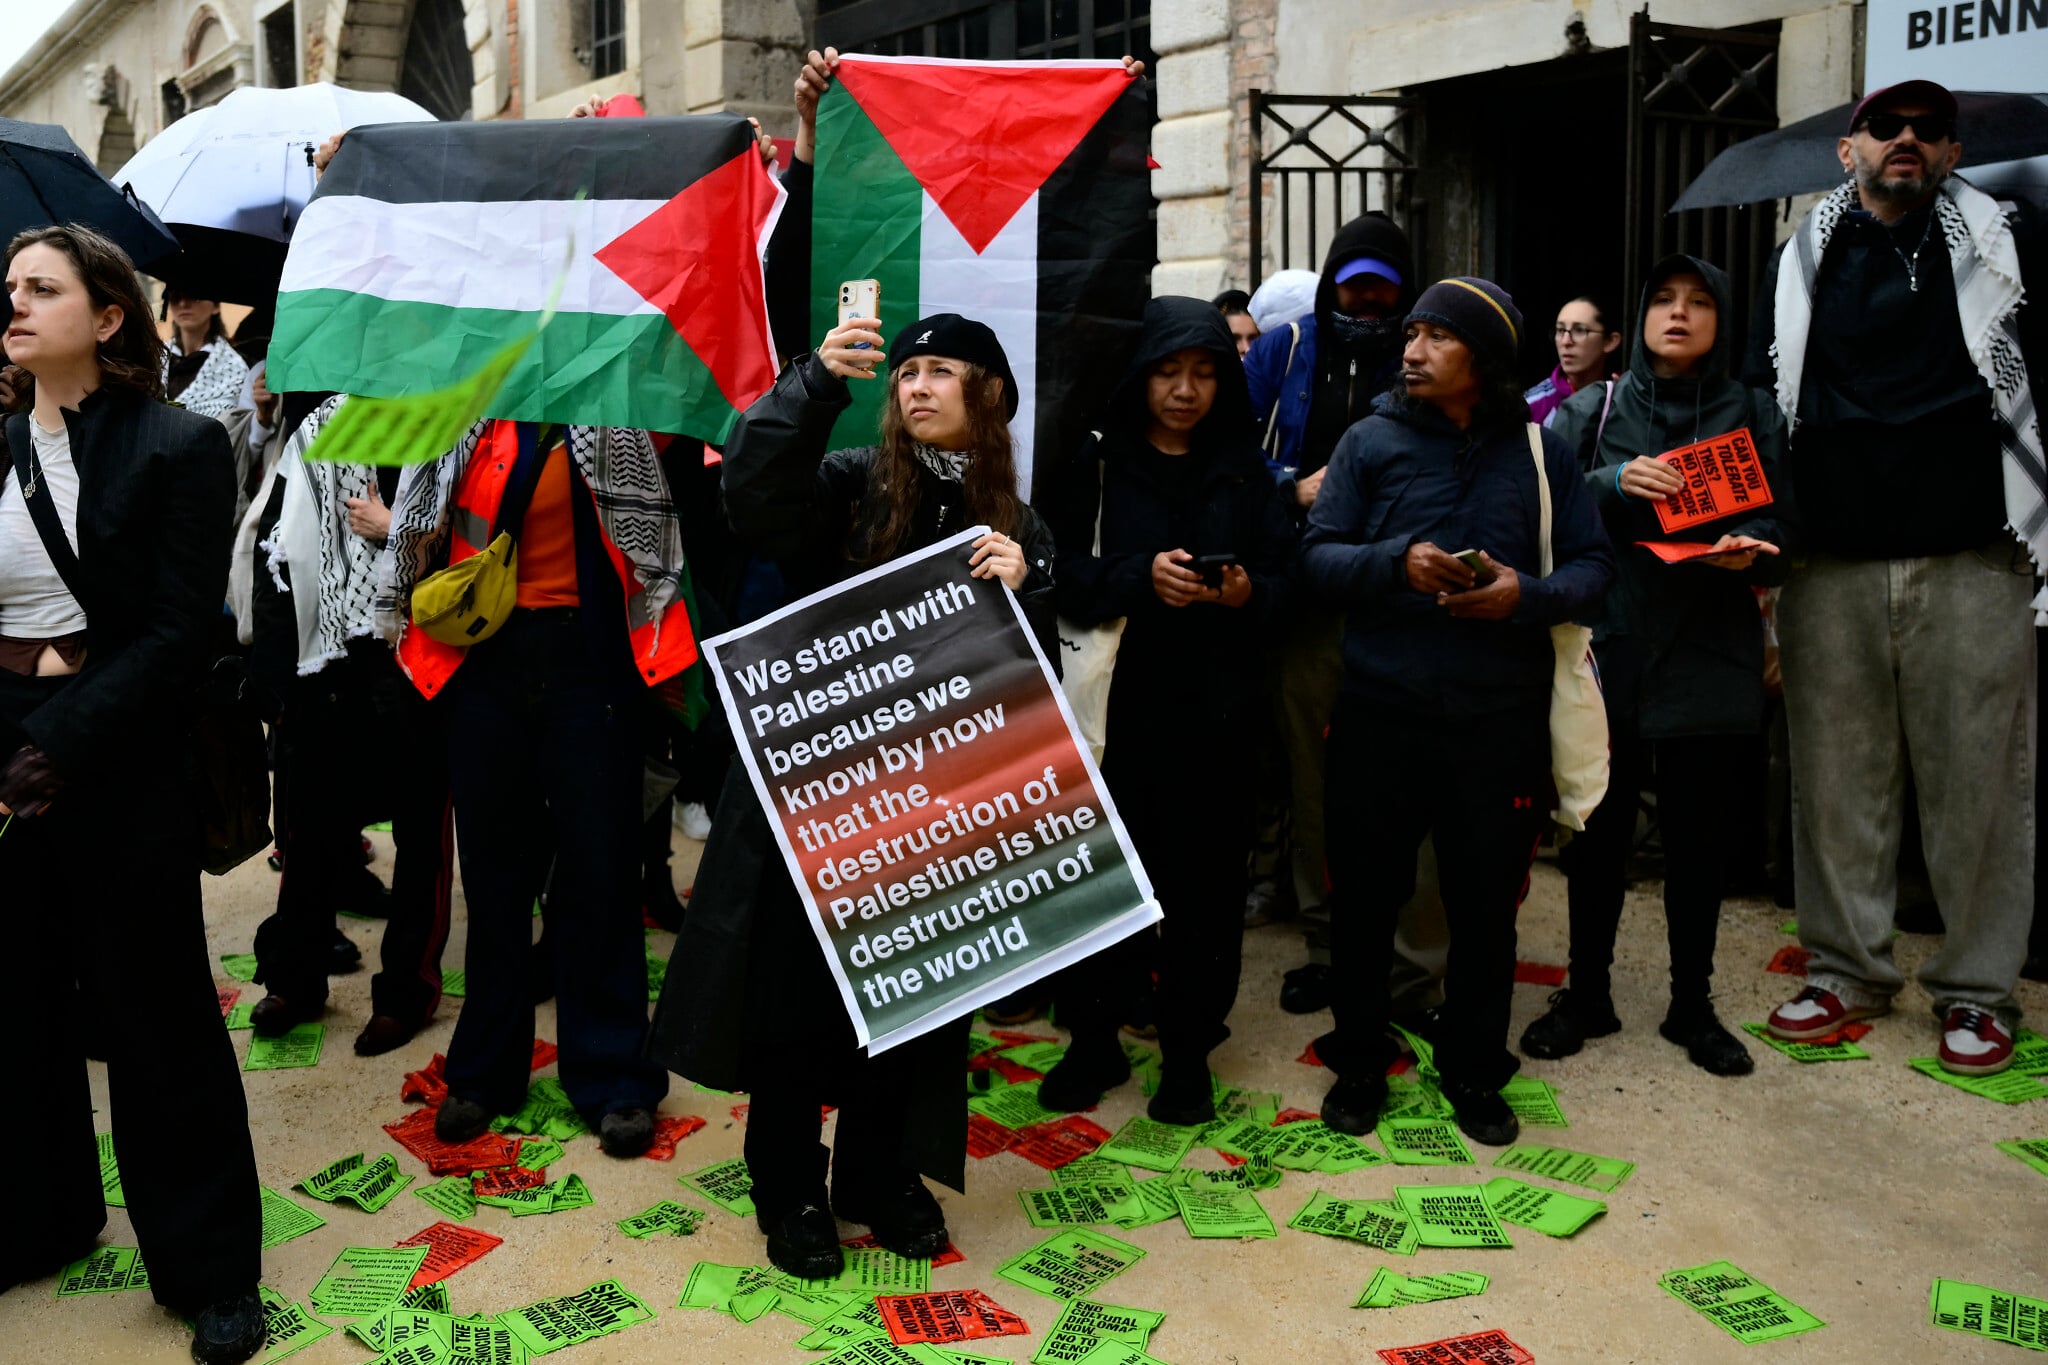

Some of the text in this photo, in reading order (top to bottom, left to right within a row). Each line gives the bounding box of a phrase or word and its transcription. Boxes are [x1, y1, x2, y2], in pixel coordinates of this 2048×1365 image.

[1907, 0, 2048, 50] BIENN
[1698, 447, 1721, 482] THIS?
[1716, 443, 1750, 503] TOLERATE
[1732, 437, 1761, 490] CAN YOU
[1668, 458, 1698, 517] GEOCIDE
[1681, 453, 1714, 515] NO TO THE
[734, 581, 975, 698] We stand with
[749, 650, 916, 737] Palestine
[764, 674, 972, 776] because we
[779, 703, 1006, 815] know by now
[797, 781, 931, 853] that the
[816, 766, 1057, 892] destruction of
[830, 804, 1097, 930] Palestine is the
[849, 843, 1095, 968] destruction of
[863, 919, 1029, 1007] the world
[310, 1159, 358, 1190] TOLERATE
[347, 1157, 393, 1192] GENOCIDE
[359, 1172, 396, 1202] PAVILION
[1421, 1195, 1480, 1204] PAVILION
[1424, 1218, 1474, 1226] VENICE
[1042, 1248, 1071, 1261] 2026
[1077, 1254, 1115, 1273] VENICE
[64, 1277, 81, 1291] END
[130, 1275, 146, 1285] NO
[1019, 1263, 1086, 1292] GENOCIDE
[1037, 1258, 1097, 1285] PAVILION
[568, 1291, 621, 1327] DOWN
[591, 1283, 638, 1313] SHUT
[1053, 1286, 1075, 1299] NO
[1076, 1302, 1103, 1312] END
[1706, 1297, 1775, 1316] NO TO THE
[519, 1308, 563, 1341] PAVILION
[536, 1302, 582, 1340] GENOCIDE
[553, 1298, 596, 1331] THE 2026
[893, 1300, 921, 1334] PAVILION
[911, 1298, 941, 1338] GENOCIDE
[928, 1295, 961, 1336] NO TO THE
[1062, 1323, 1096, 1335] NOW.
[1071, 1309, 1138, 1328] CULTURAL
[1720, 1305, 1786, 1325] GENOCIDE
[1732, 1314, 1793, 1333] PAVILION
[1940, 1313, 1959, 1326] NO
[1963, 1302, 1983, 1331] DEATH
[1989, 1295, 2010, 1334] IN VENICE
[2017, 1304, 2036, 1342] NO TO THE
[455, 1324, 471, 1343] THE
[1050, 1341, 1092, 1354] GENO
[1055, 1334, 1098, 1346] NO TO
[841, 1351, 859, 1361] AT
